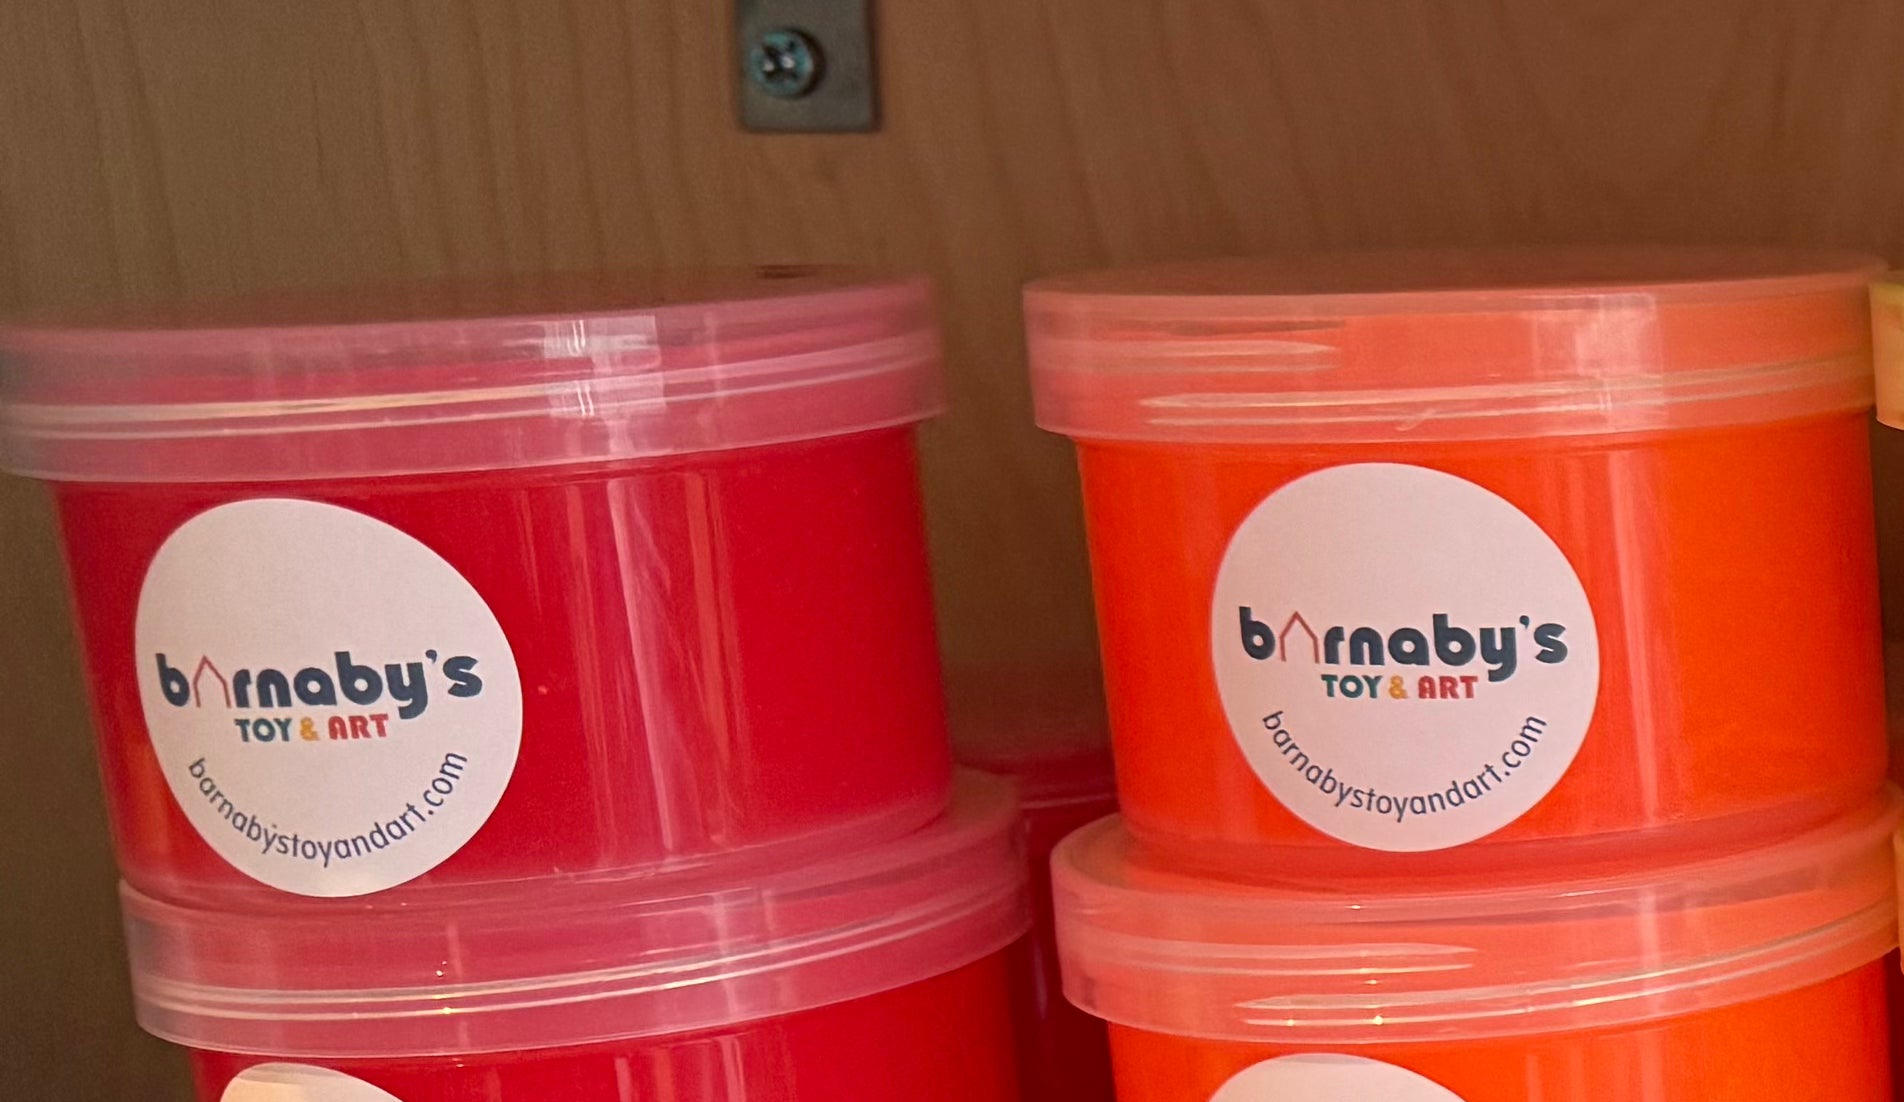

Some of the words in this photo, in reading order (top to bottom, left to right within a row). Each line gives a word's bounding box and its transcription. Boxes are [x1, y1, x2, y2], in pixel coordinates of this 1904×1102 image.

[1319, 672, 1383, 699] TOY
[1388, 674, 1408, 701] &
[1415, 673, 1480, 700] ART
[233, 716, 292, 745] TOY
[299, 715, 321, 743] &
[328, 710, 392, 741] ART
[1261, 709, 1550, 824] barnabystoyandart.com
[188, 749, 470, 869] barnabystoyandart.com
